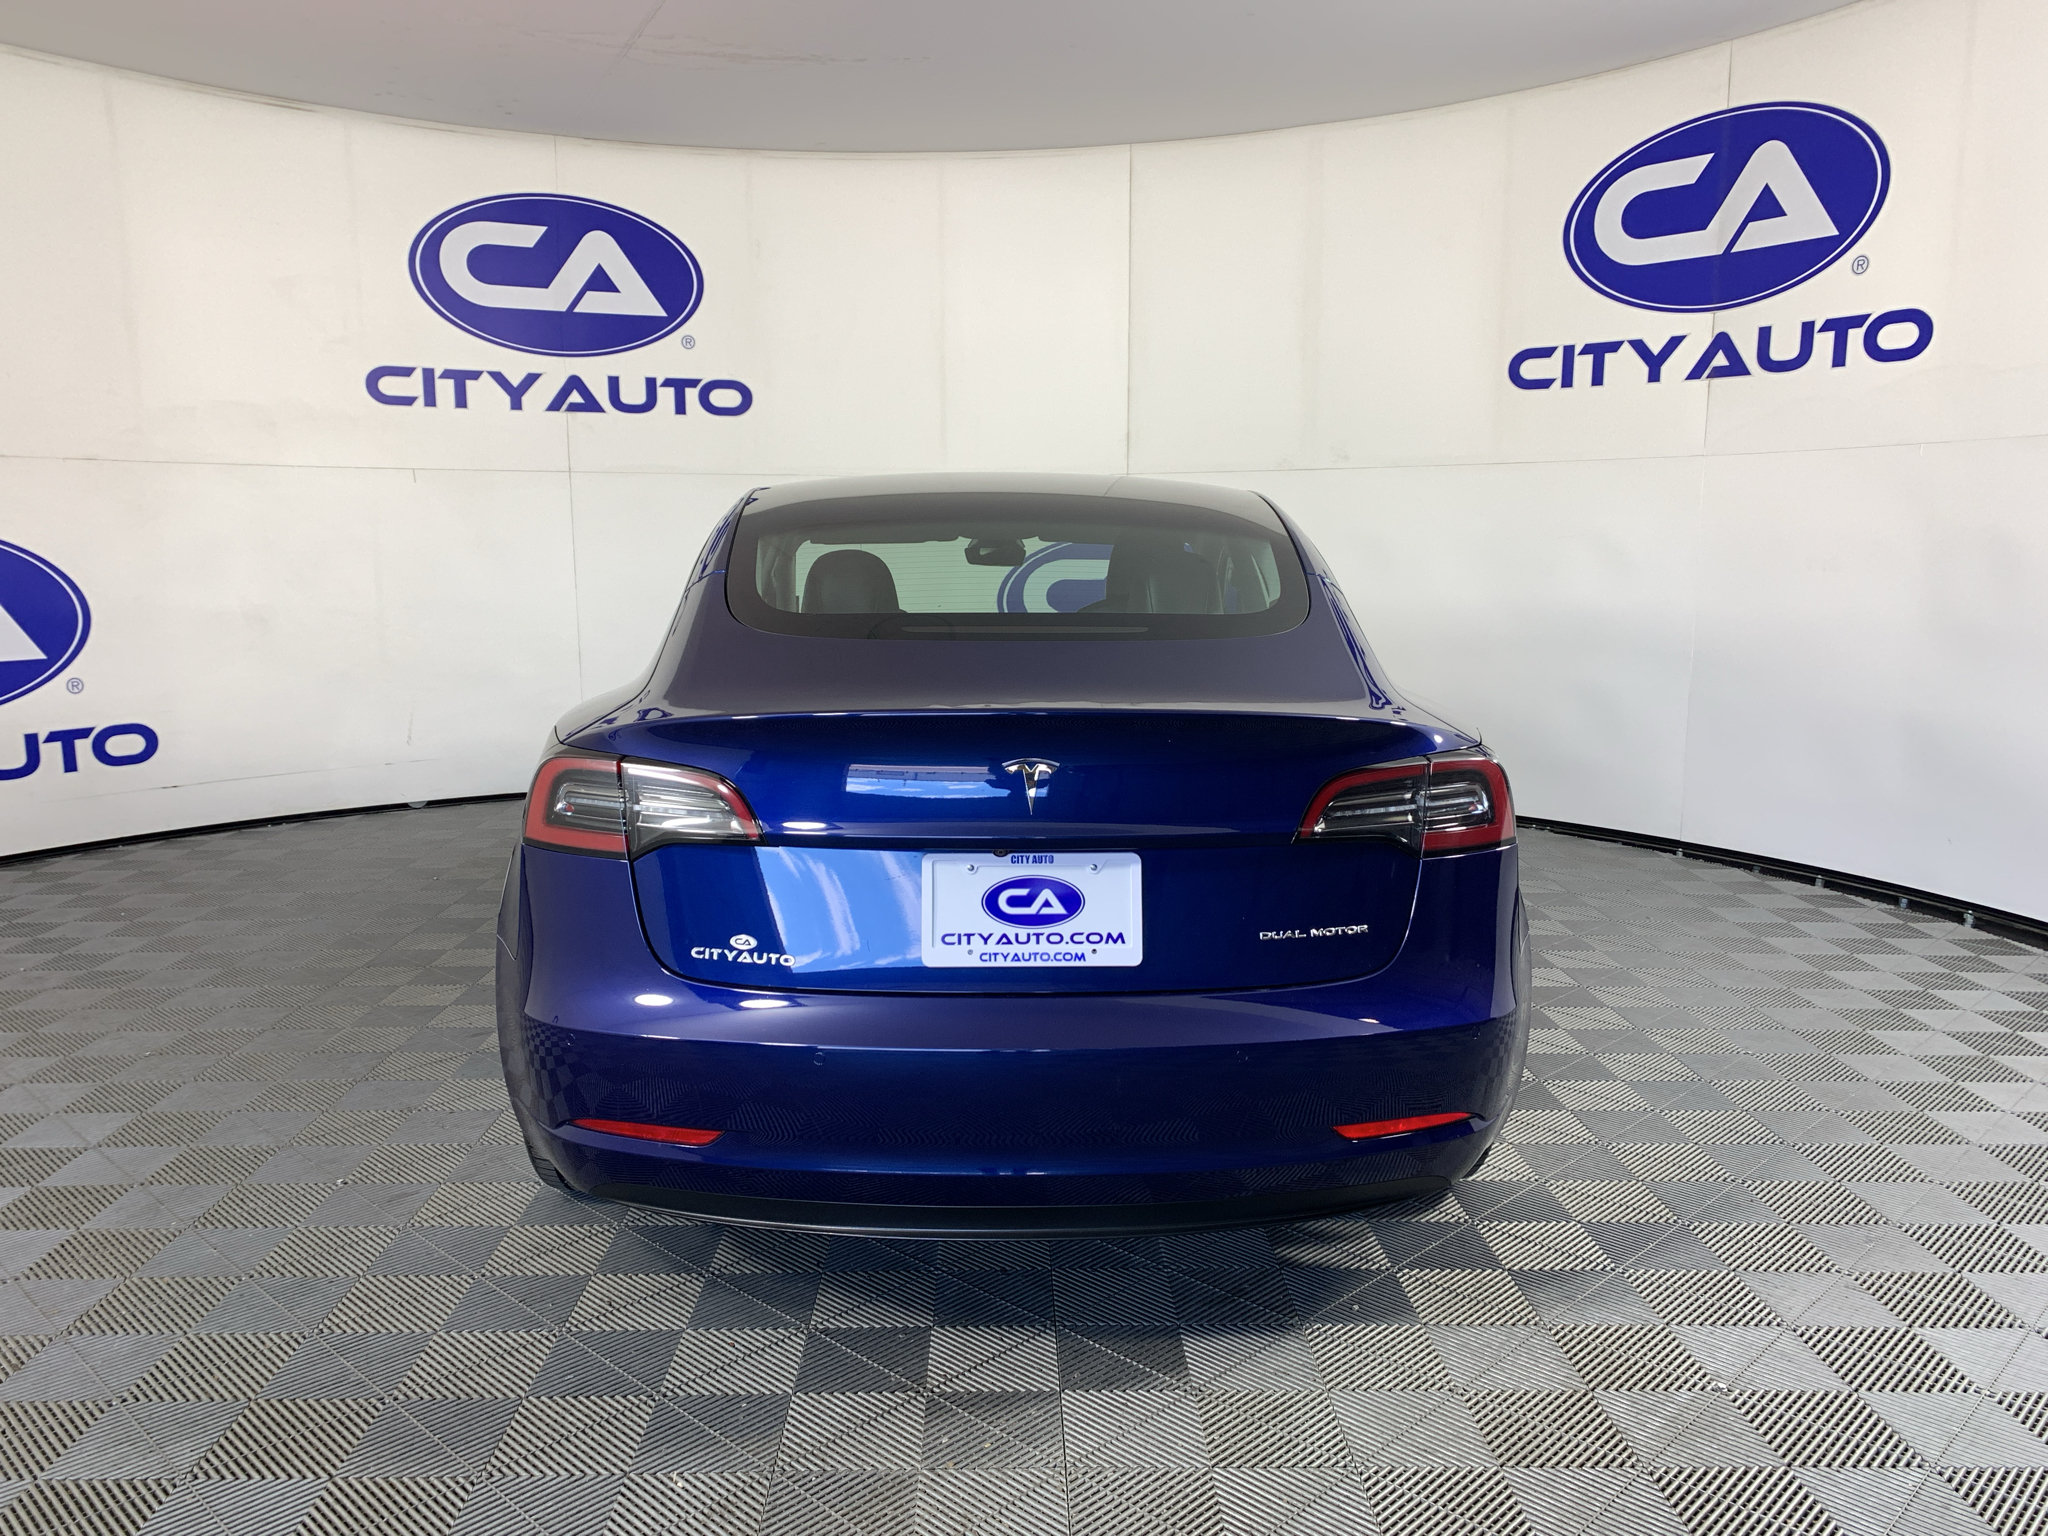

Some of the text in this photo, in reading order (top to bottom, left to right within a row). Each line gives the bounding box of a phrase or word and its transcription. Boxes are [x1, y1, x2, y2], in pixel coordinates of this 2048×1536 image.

[1594, 139, 1840, 266] CA
[438, 221, 669, 317] CA
[1010, 854, 1054, 865] CITY AUTO
[998, 888, 1068, 915] CA
[940, 932, 1126, 946] CITYAUTO.COM
[1260, 925, 1368, 940] DUAL MOTOR
[979, 952, 1086, 962] CITYAUTO.COM
